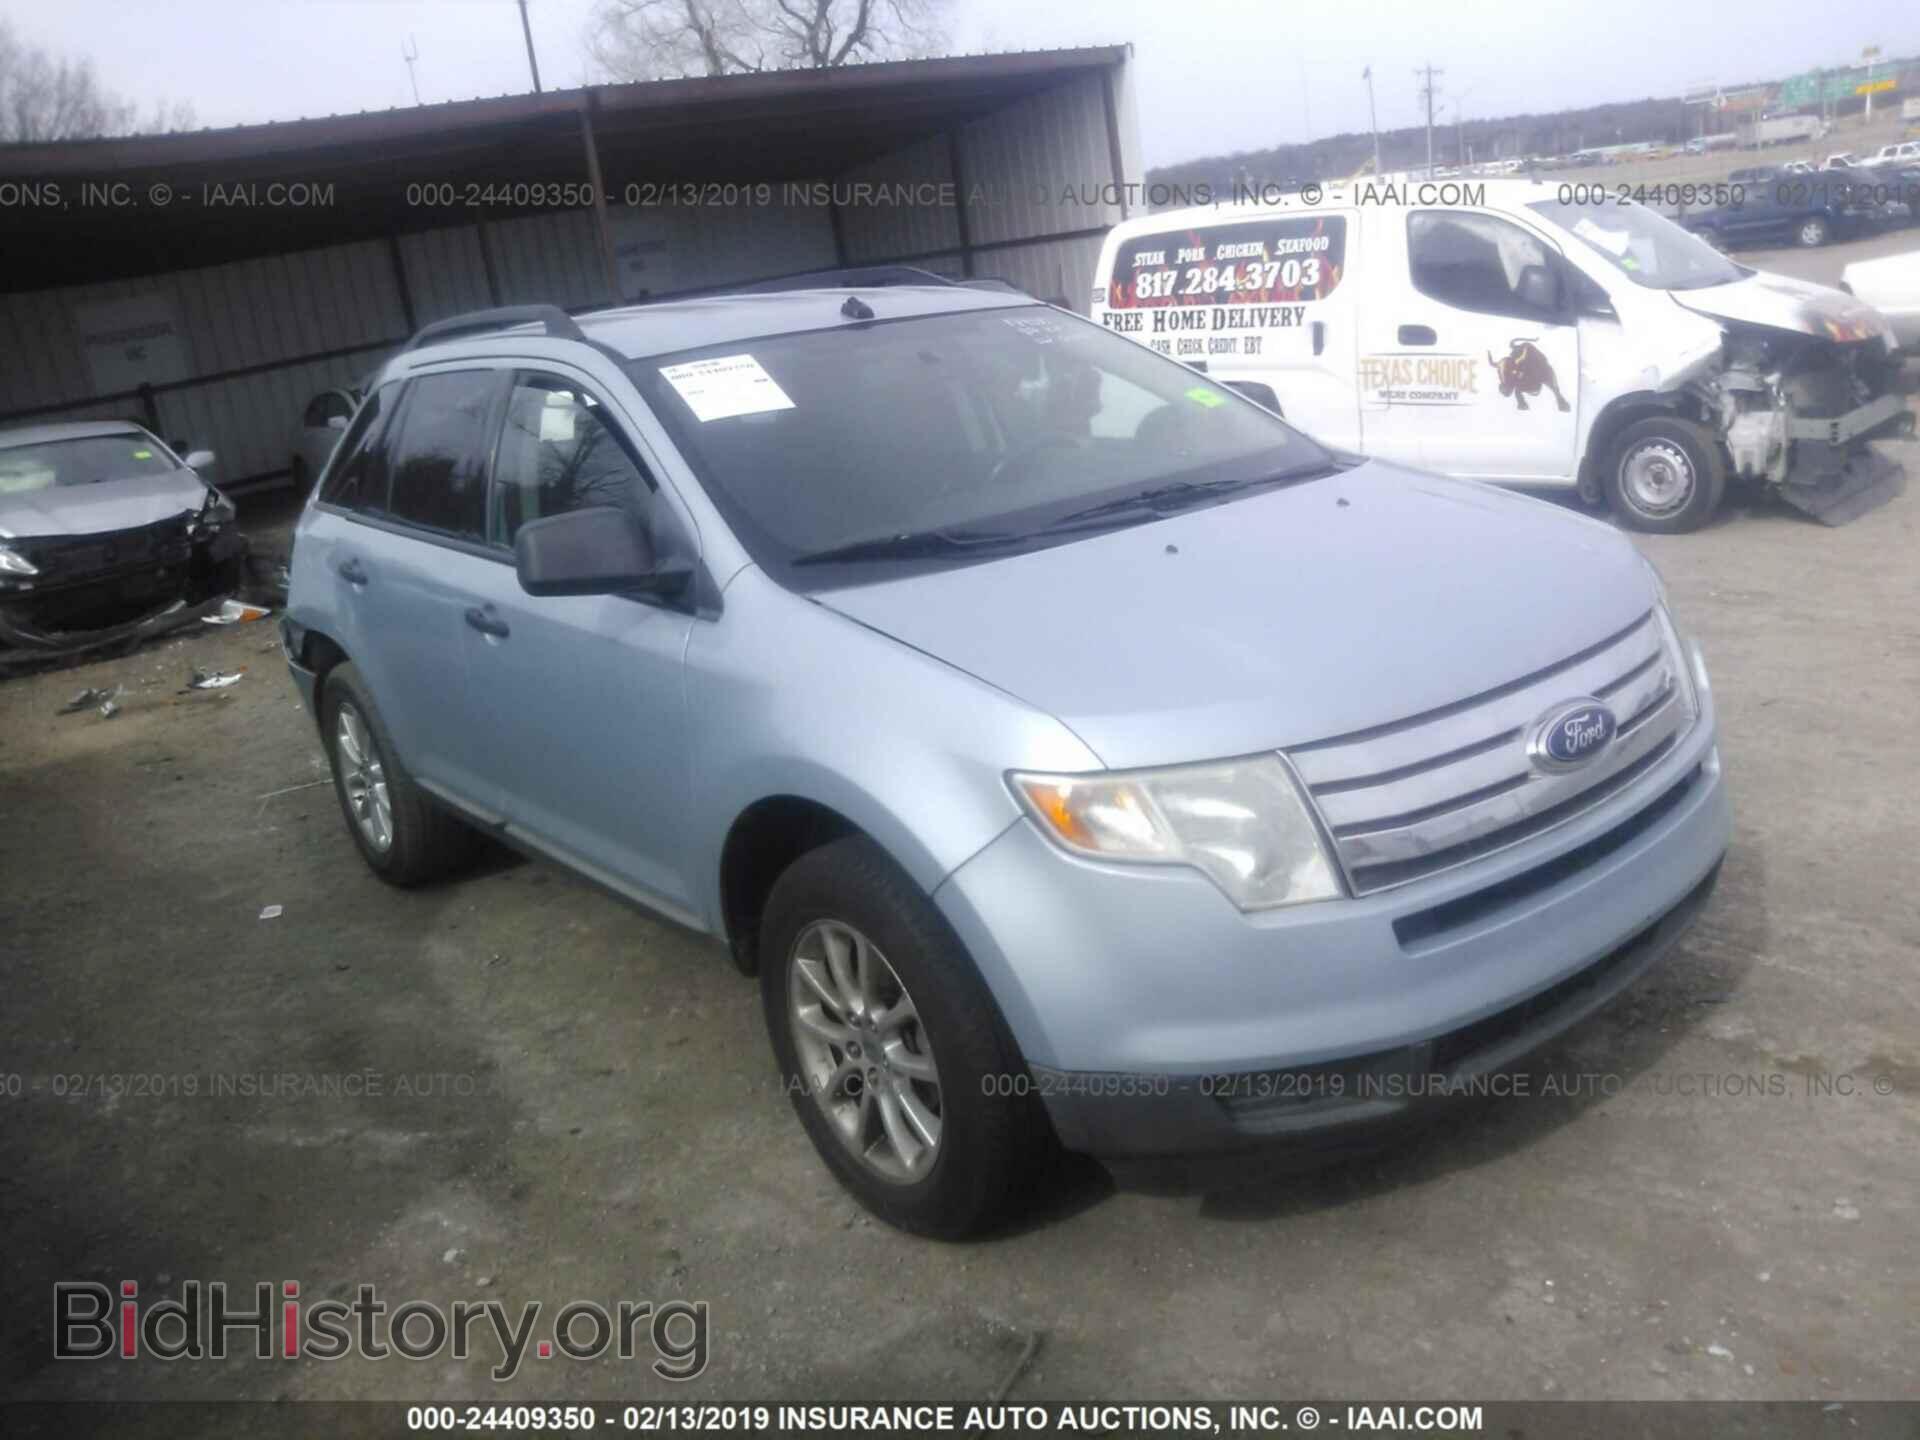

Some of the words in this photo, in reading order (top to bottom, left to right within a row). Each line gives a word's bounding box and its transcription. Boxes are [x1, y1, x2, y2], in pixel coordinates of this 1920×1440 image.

[1132, 250, 1165, 268] STEAK
[1175, 246, 1206, 265] PORK
[1214, 240, 1265, 261] CHICKEN
[1275, 236, 1329, 256] SEAFOOD
[1135, 258, 1320, 299] 817.284.3703
[1102, 311, 1144, 333] FREE
[1152, 309, 1207, 333] HOME
[1210, 305, 1306, 331] DELIVERY
[1177, 337, 1204, 356] CHECK
[1208, 336, 1238, 355] CREDIT
[1244, 335, 1263, 355] EBT
[1360, 357, 1413, 392] TEXAS
[1416, 358, 1479, 394] CHOICE
[1563, 713, 1607, 754] Ford
